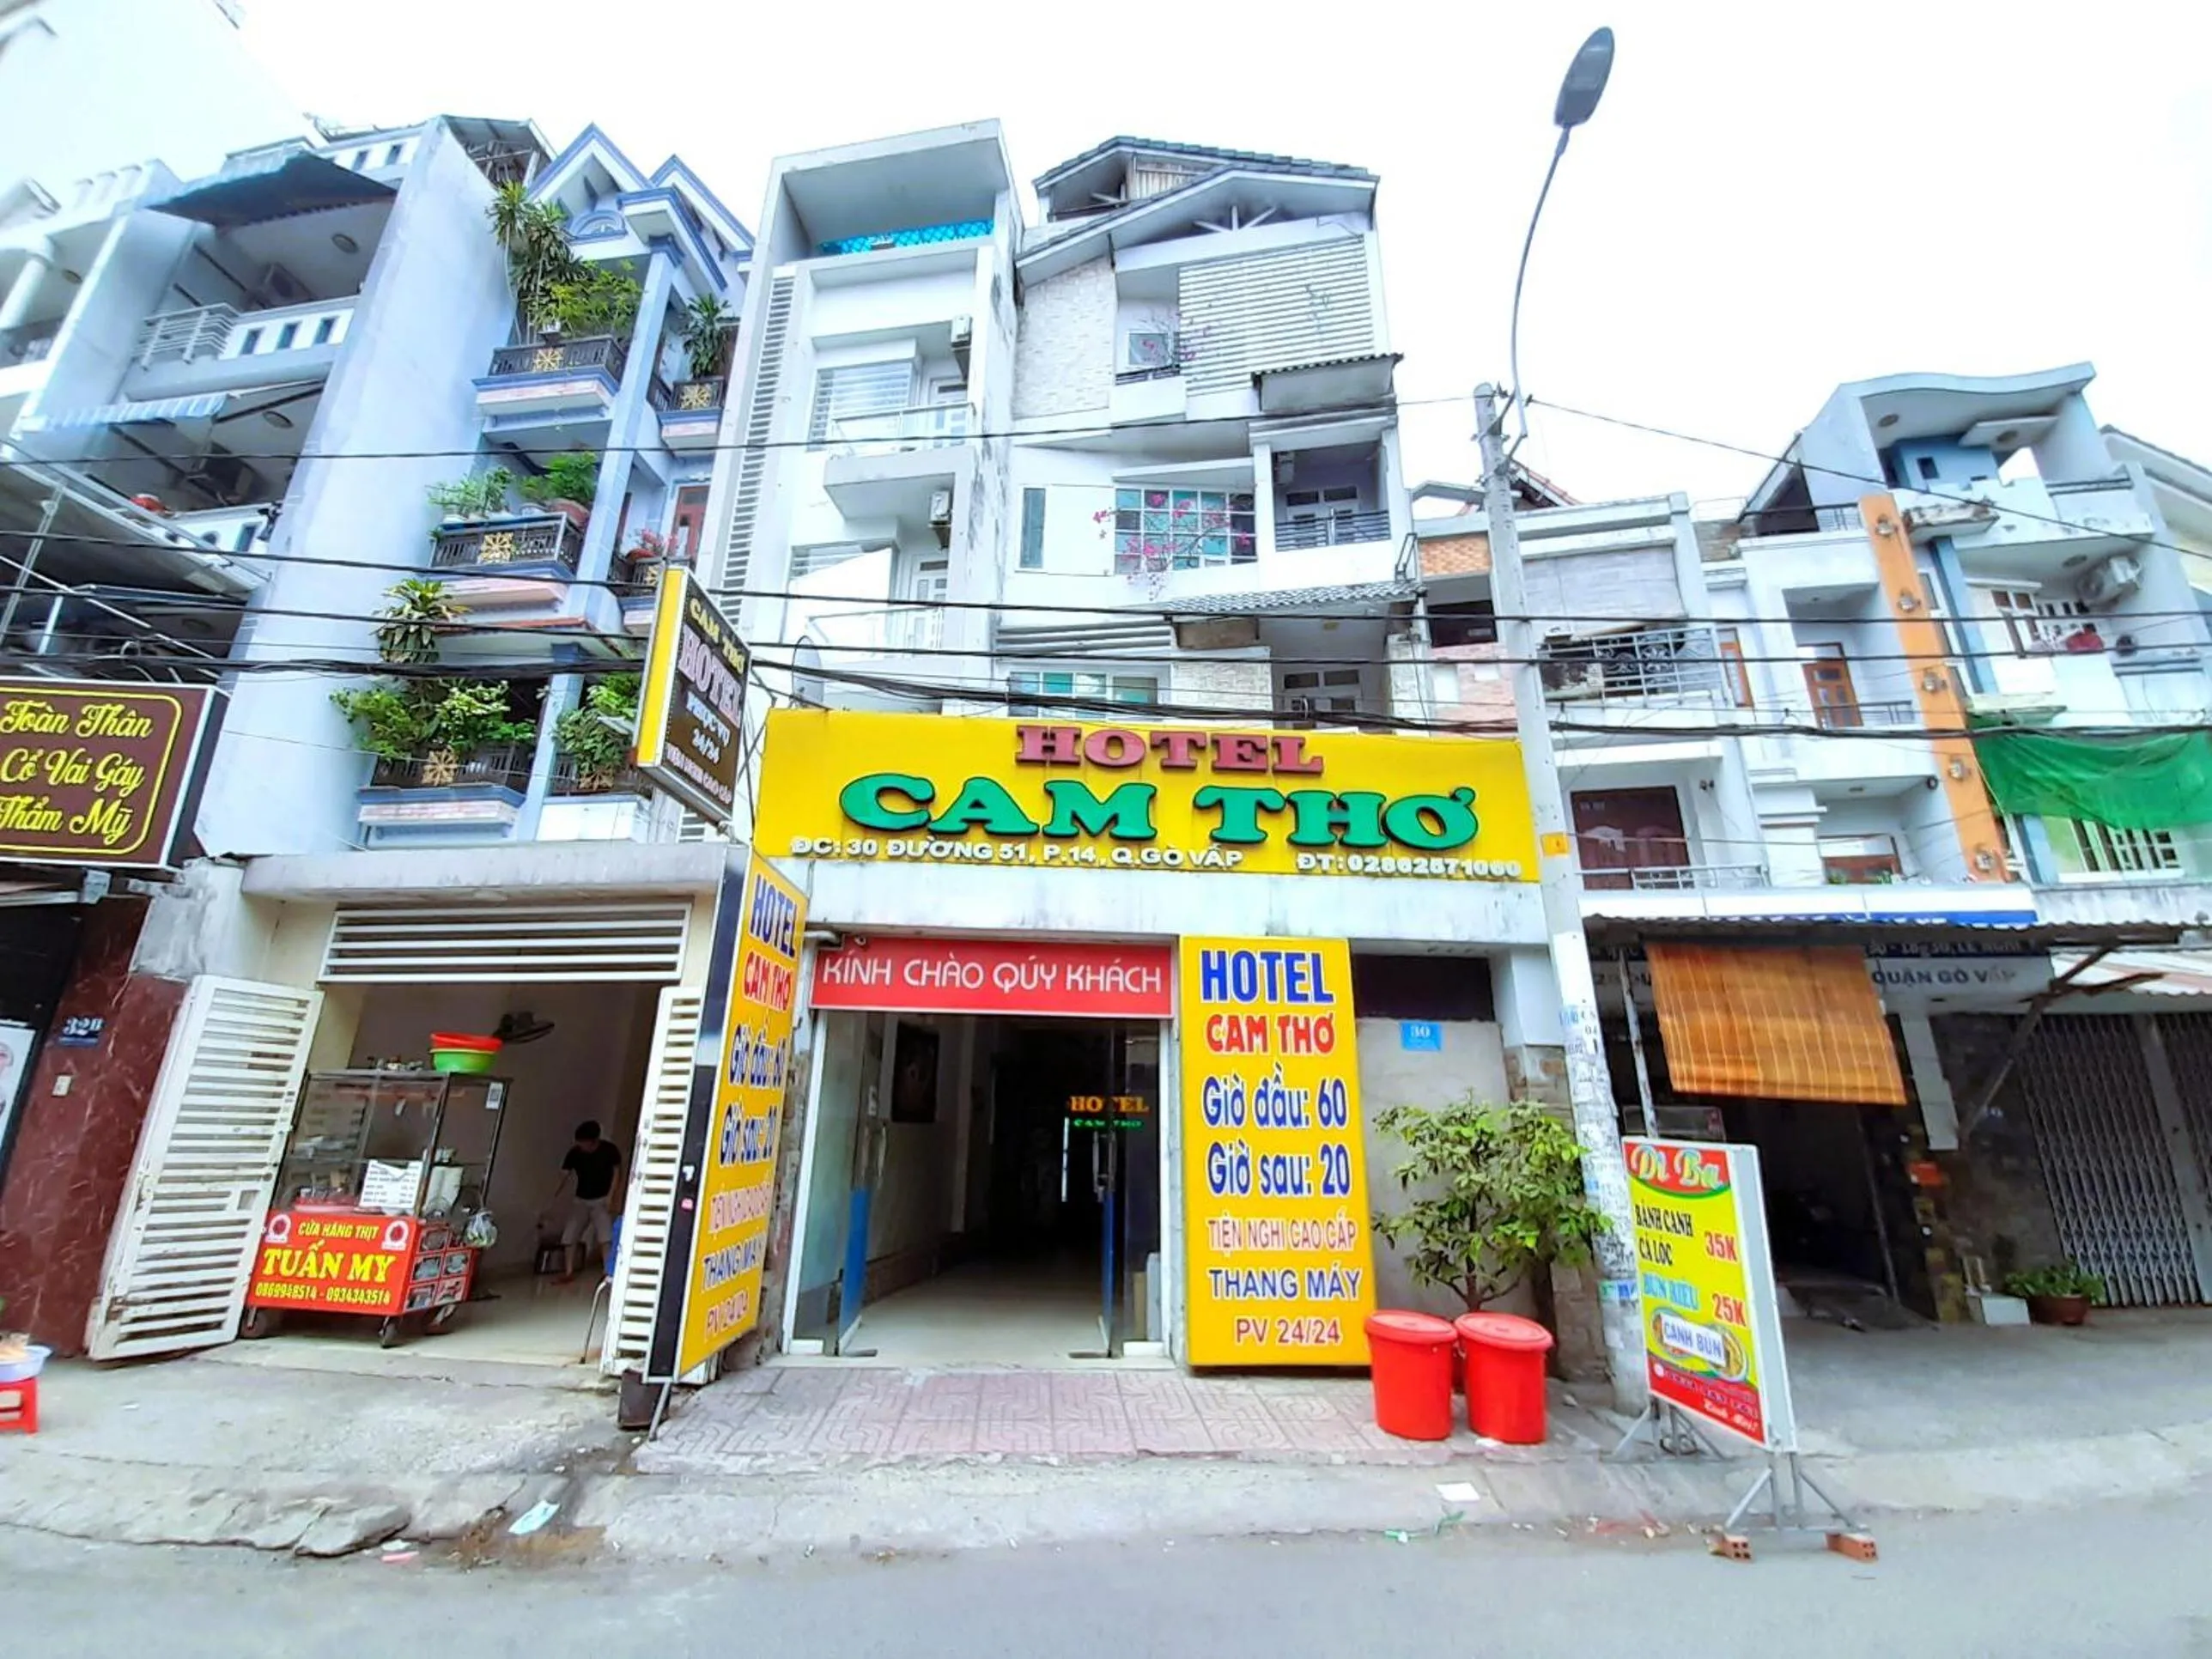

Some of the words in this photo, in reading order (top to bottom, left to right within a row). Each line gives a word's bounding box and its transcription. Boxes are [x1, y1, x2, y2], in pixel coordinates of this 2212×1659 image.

[678, 623, 741, 728] HOTEL
[0, 700, 70, 733] Toàn
[75, 703, 153, 738] Thân
[1016, 725, 1324, 775] HOTEL
[0, 748, 44, 782] Cổ
[45, 747, 93, 786] Vai
[94, 752, 145, 797] Gáy
[0, 795, 63, 831] Thẩm
[69, 798, 133, 846] Mỹ
[839, 774, 1158, 841] CAM
[1194, 785, 1479, 851] THƠ
[790, 836, 841, 855] ĐC:
[846, 838, 878, 855] 30
[887, 836, 993, 860] ĐƯỜNG
[1188, 844, 1243, 869] VẤP
[750, 873, 798, 959] HOTEL
[744, 951, 770, 1004] CAM
[822, 950, 891, 986] KÍNH
[902, 951, 984, 989] CHÀO
[1066, 957, 1161, 994] KHÁCH
[1201, 949, 1335, 1004] HOTEL
[1872, 967, 1932, 988] QUẬN
[1938, 968, 1968, 984] GÒ
[1206, 1013, 1269, 1054] CAM
[1276, 1012, 1336, 1055] THƠ
[1070, 1096, 1149, 1112] HOEL
[1203, 1073, 1245, 1127] Giờ
[1254, 1060, 1311, 1128] đầu:
[1318, 1079, 1347, 1128] 60
[1206, 1139, 1251, 1195] Giờ
[1259, 1153, 1312, 1196] sau:
[1320, 1143, 1351, 1196] 20
[1208, 1211, 1243, 1254] TIỆN
[1248, 1219, 1285, 1249] NGHI
[1290, 1219, 1322, 1249] CAO
[1326, 1208, 1357, 1249] CẤP
[1635, 1199, 1662, 1231] BÁNH
[1663, 1209, 1693, 1237] CANH
[262, 1240, 344, 1279] TUẤN
[1705, 1231, 1738, 1262] 35K
[1208, 1269, 1297, 1299] THANG
[1307, 1261, 1361, 1299] MÁY
[1711, 1292, 1747, 1327] 25K
[1236, 1318, 1267, 1344] PV
[1277, 1318, 1340, 1345] 24/24
[1663, 1322, 1692, 1347] CANH
